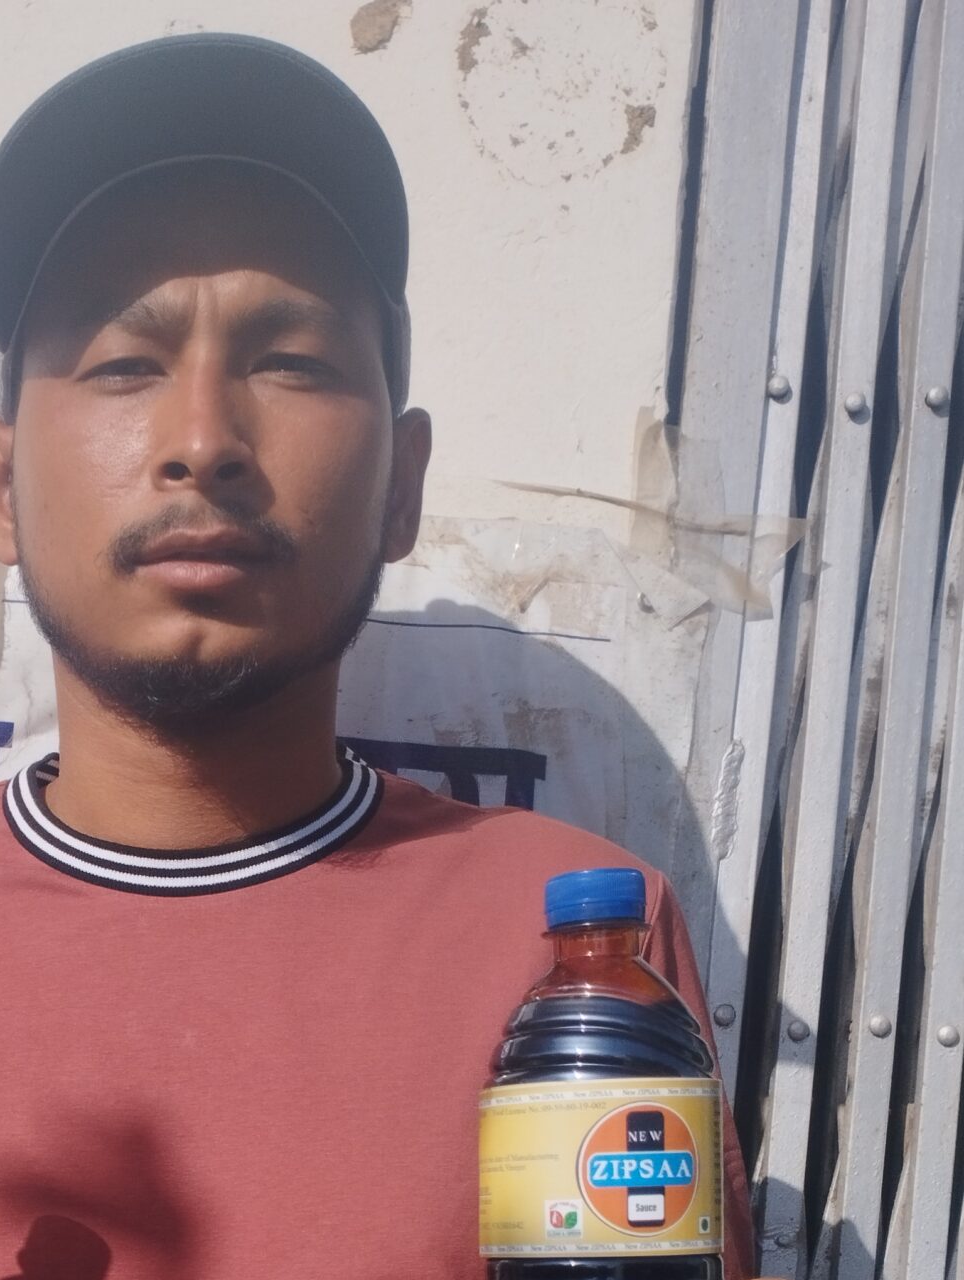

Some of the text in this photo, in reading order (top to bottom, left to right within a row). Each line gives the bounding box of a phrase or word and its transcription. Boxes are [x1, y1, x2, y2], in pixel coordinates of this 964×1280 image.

[628, 1130, 663, 1143] NEW
[591, 1158, 692, 1181] ZIPSAA
[635, 1202, 657, 1213] Sauce
